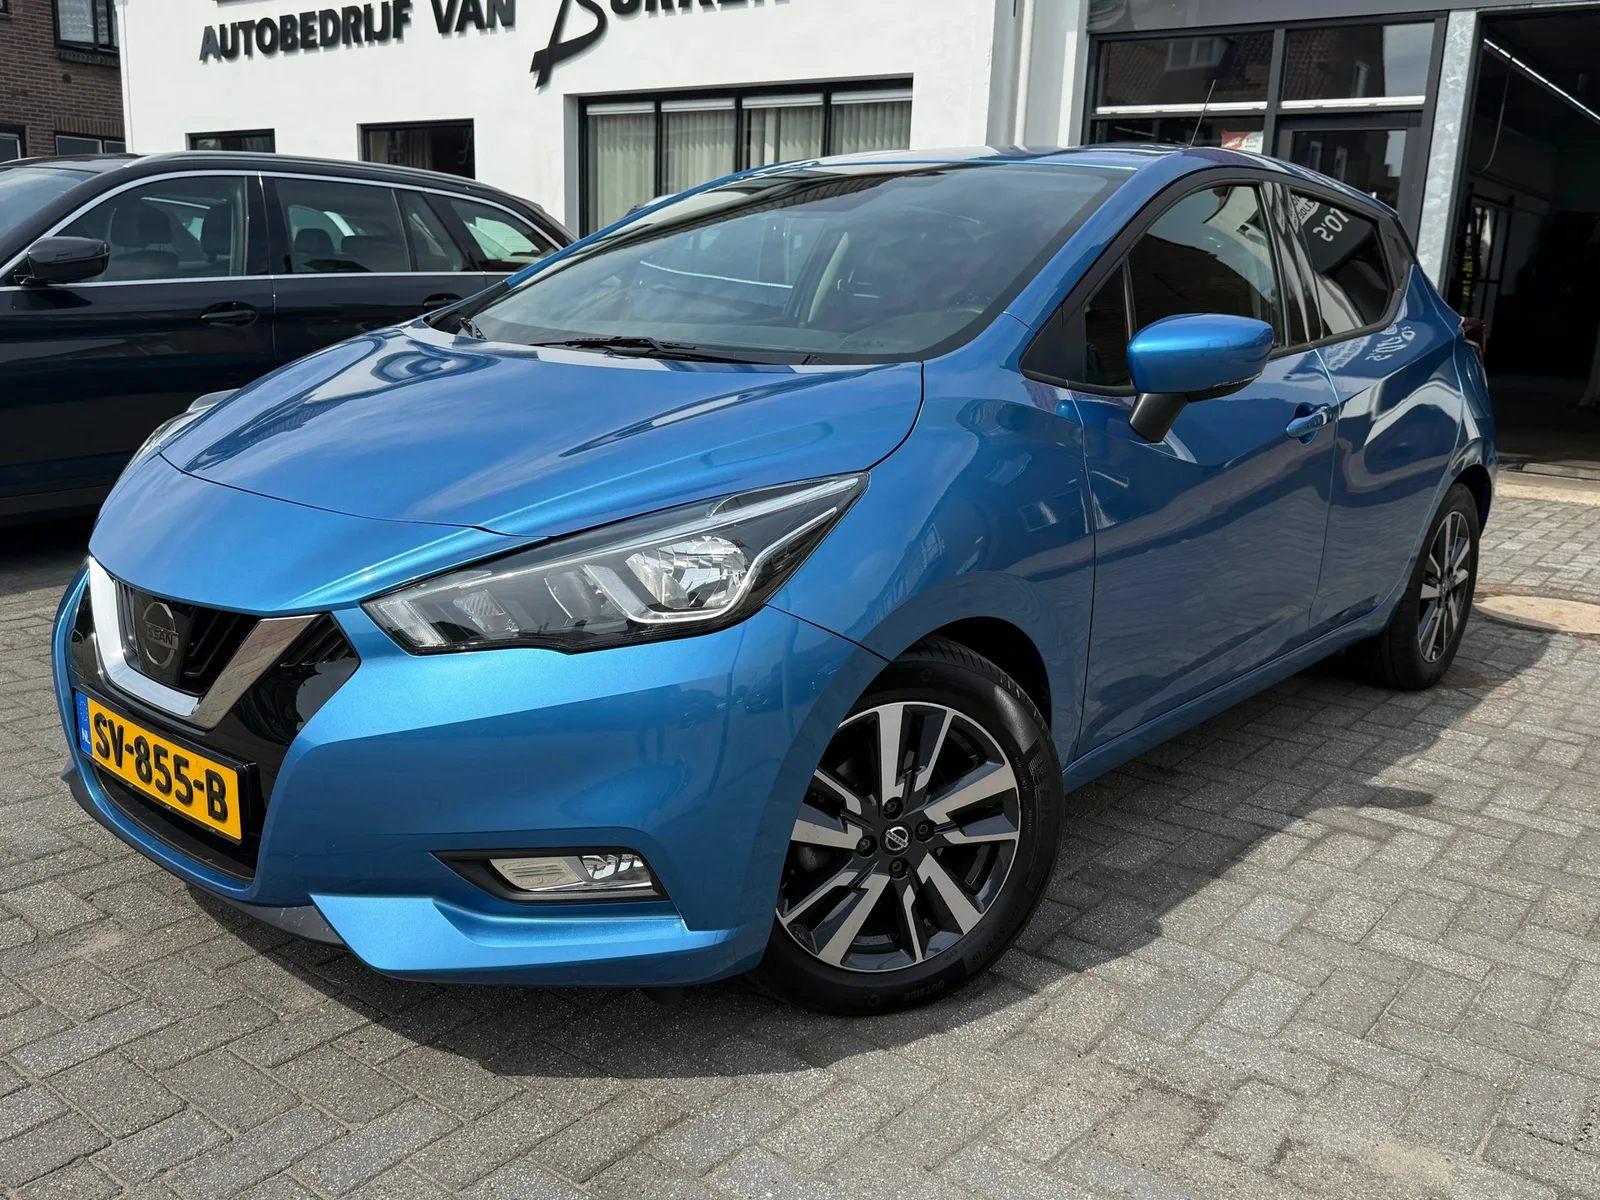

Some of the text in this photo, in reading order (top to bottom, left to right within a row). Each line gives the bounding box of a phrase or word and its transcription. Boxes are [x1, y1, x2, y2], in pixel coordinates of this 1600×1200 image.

[198, 0, 516, 63] AUTOBEDRIJF VAN
[81, 727, 91, 745] NL
[93, 711, 229, 822] SV-855-B
